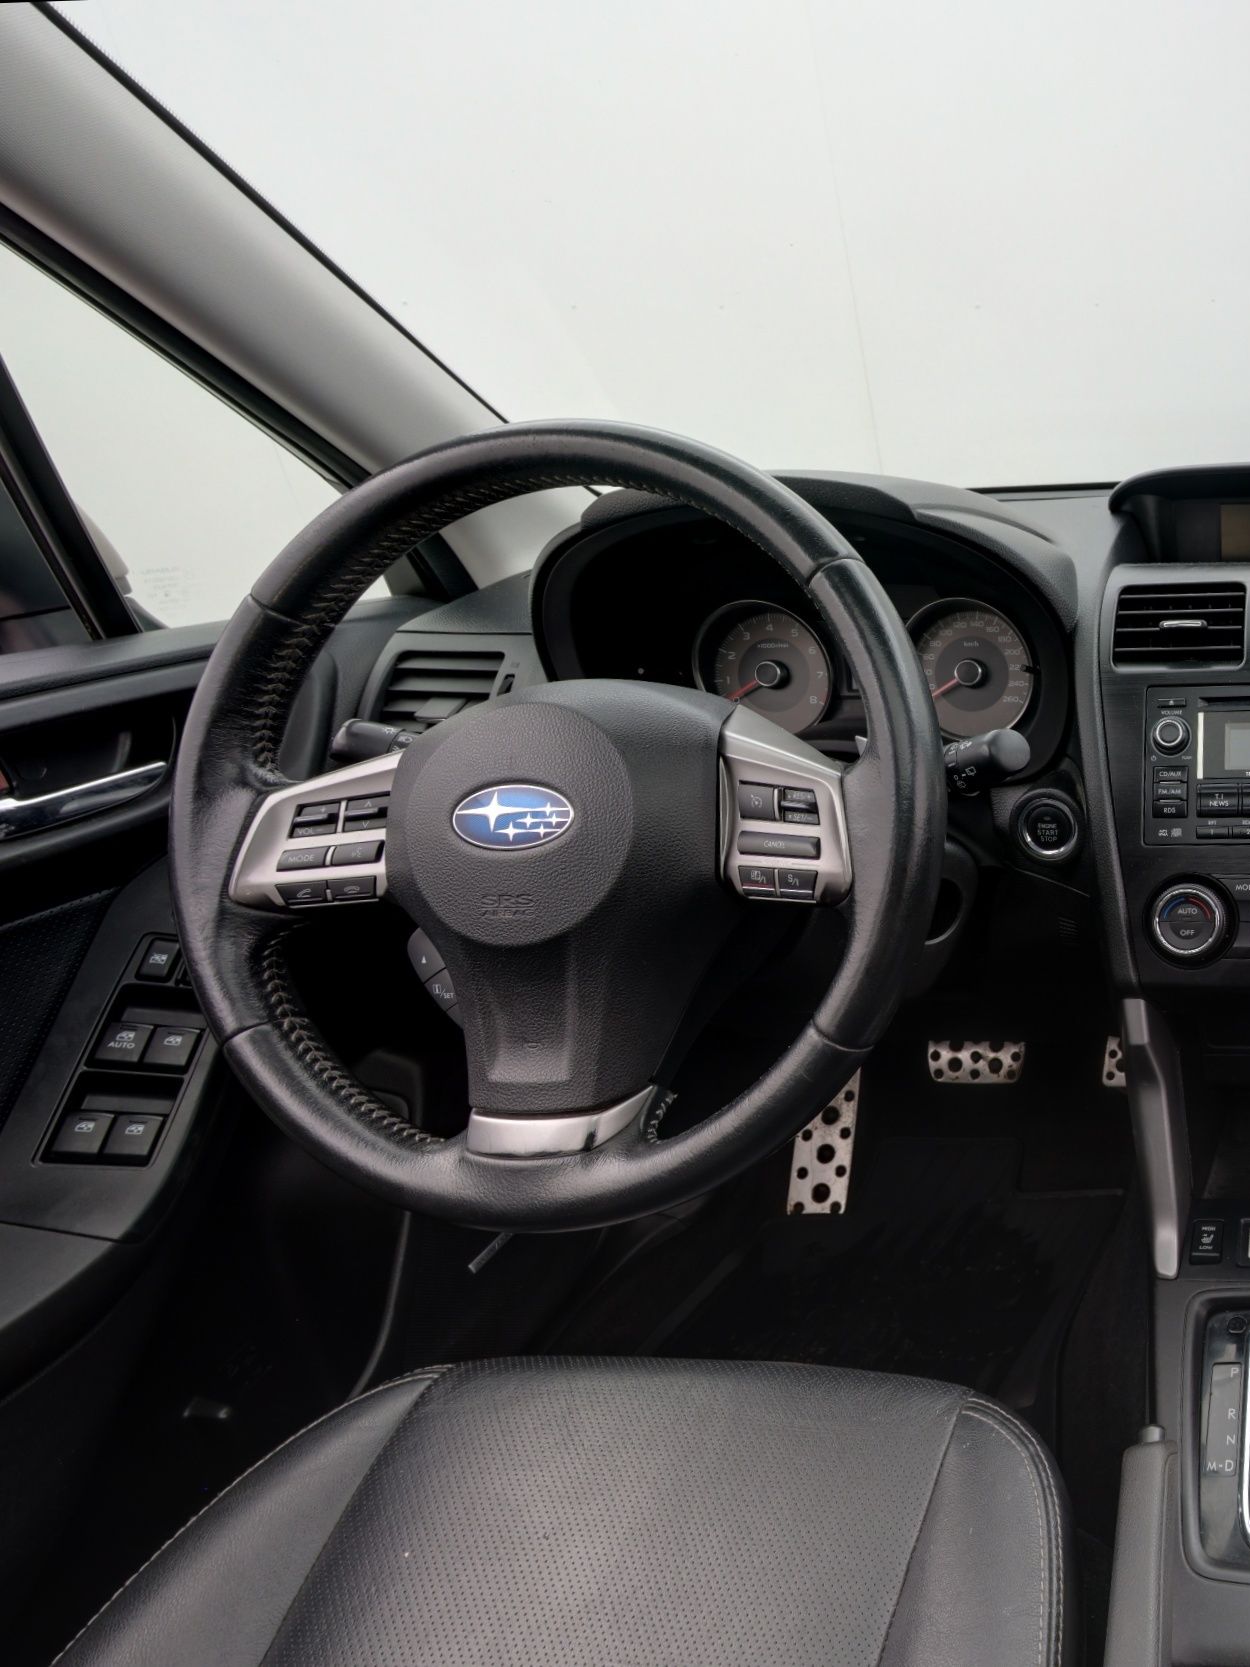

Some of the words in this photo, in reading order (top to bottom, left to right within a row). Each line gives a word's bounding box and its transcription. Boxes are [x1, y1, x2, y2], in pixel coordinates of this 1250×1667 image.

[766, 624, 774, 632] 4
[743, 632, 751, 641] 3
[791, 629, 799, 637] 5
[808, 646, 817, 655] 6
[727, 651, 737, 660] 2
[816, 671, 824, 679] 7
[809, 695, 818, 704] 8
[288, 854, 316, 864] MODE
[480, 894, 536, 909] SRS
[107, 1041, 136, 1050] AUTO
[1230, 1367, 1240, 1378] P
[1227, 1408, 1236, 1420] R
[1226, 1434, 1236, 1446] N
